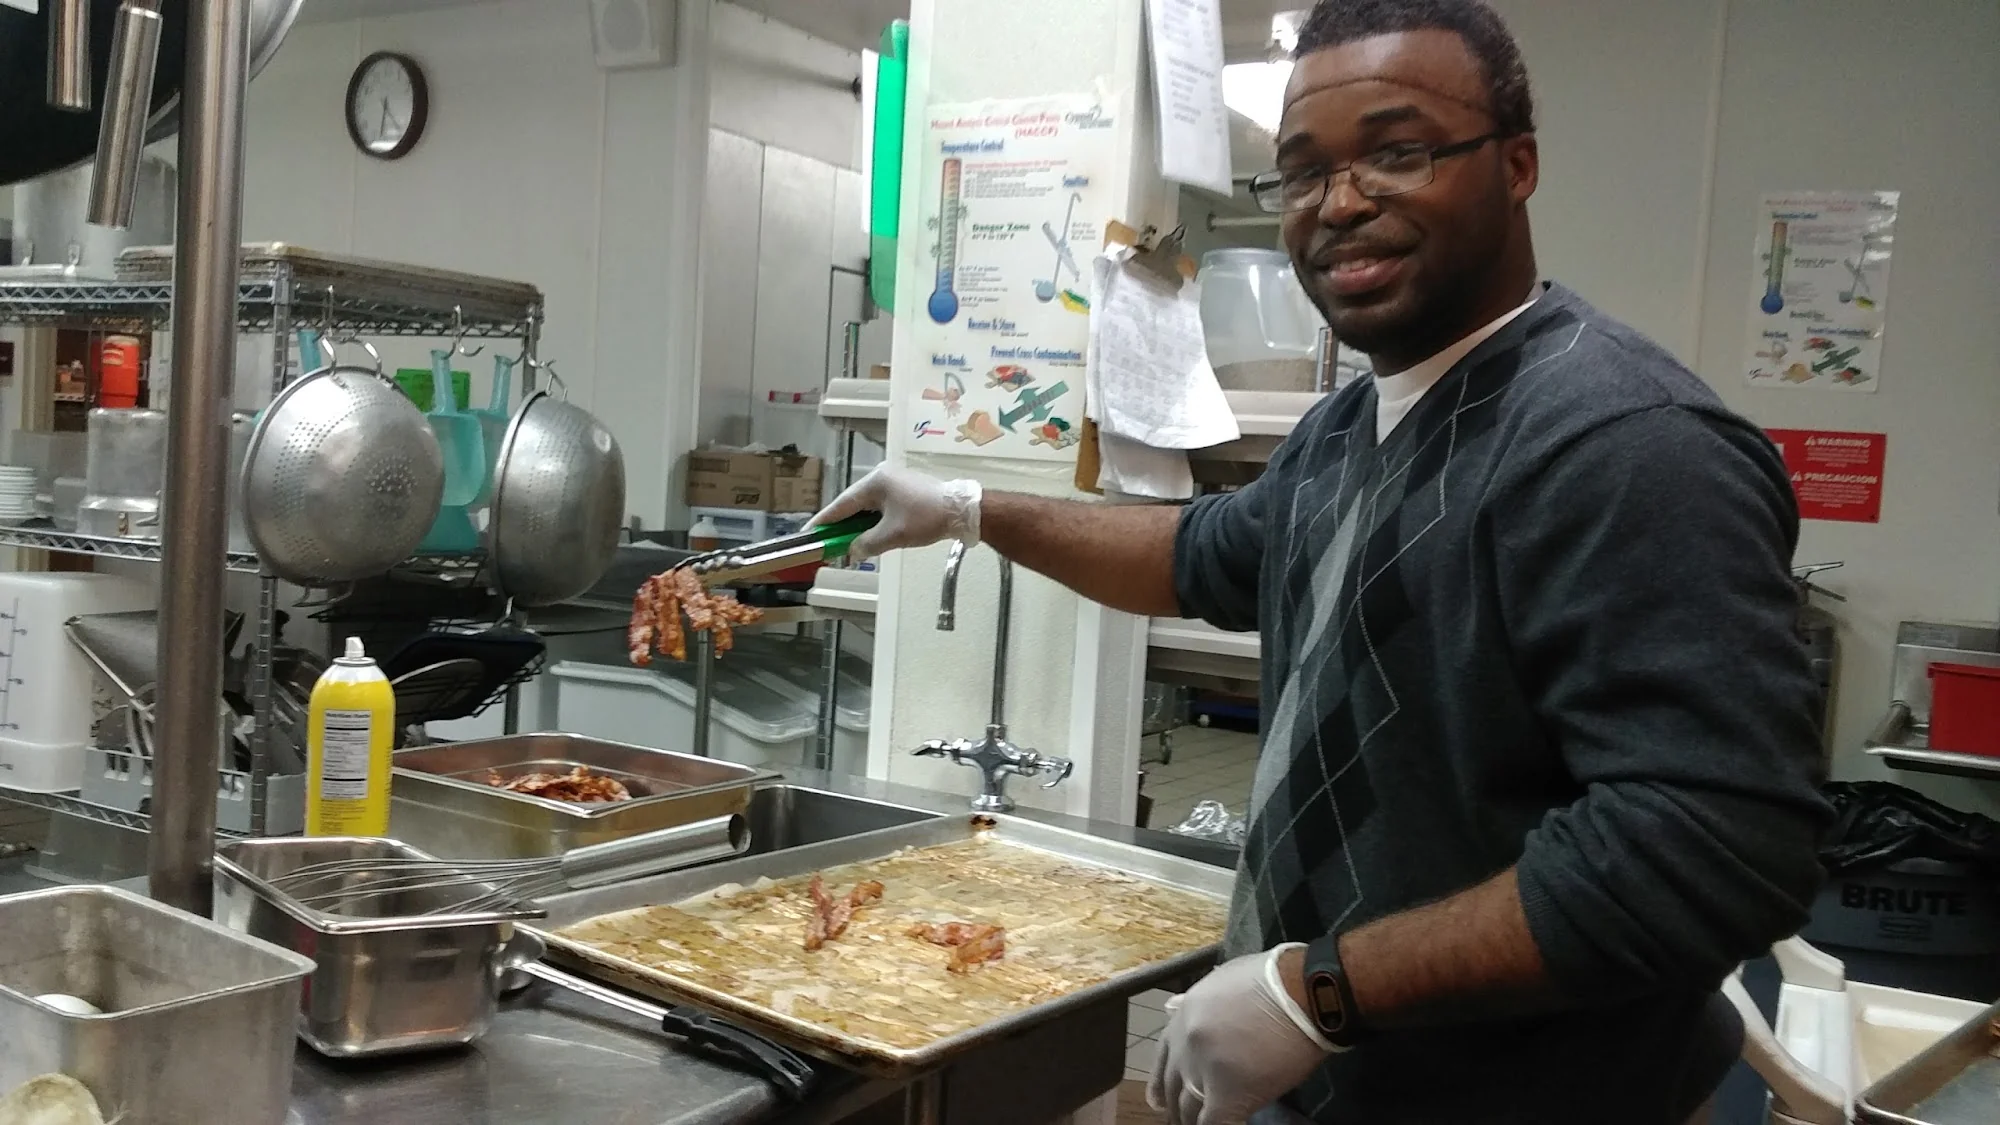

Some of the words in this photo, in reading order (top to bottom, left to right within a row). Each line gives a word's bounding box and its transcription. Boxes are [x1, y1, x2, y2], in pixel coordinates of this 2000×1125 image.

[972, 222, 1005, 233] Danger
[1006, 222, 1031, 232] Zone
[1817, 437, 1872, 448] WARNING
[1803, 472, 1878, 485] PRECAUCION
[1842, 883, 1967, 917] BRUTE
